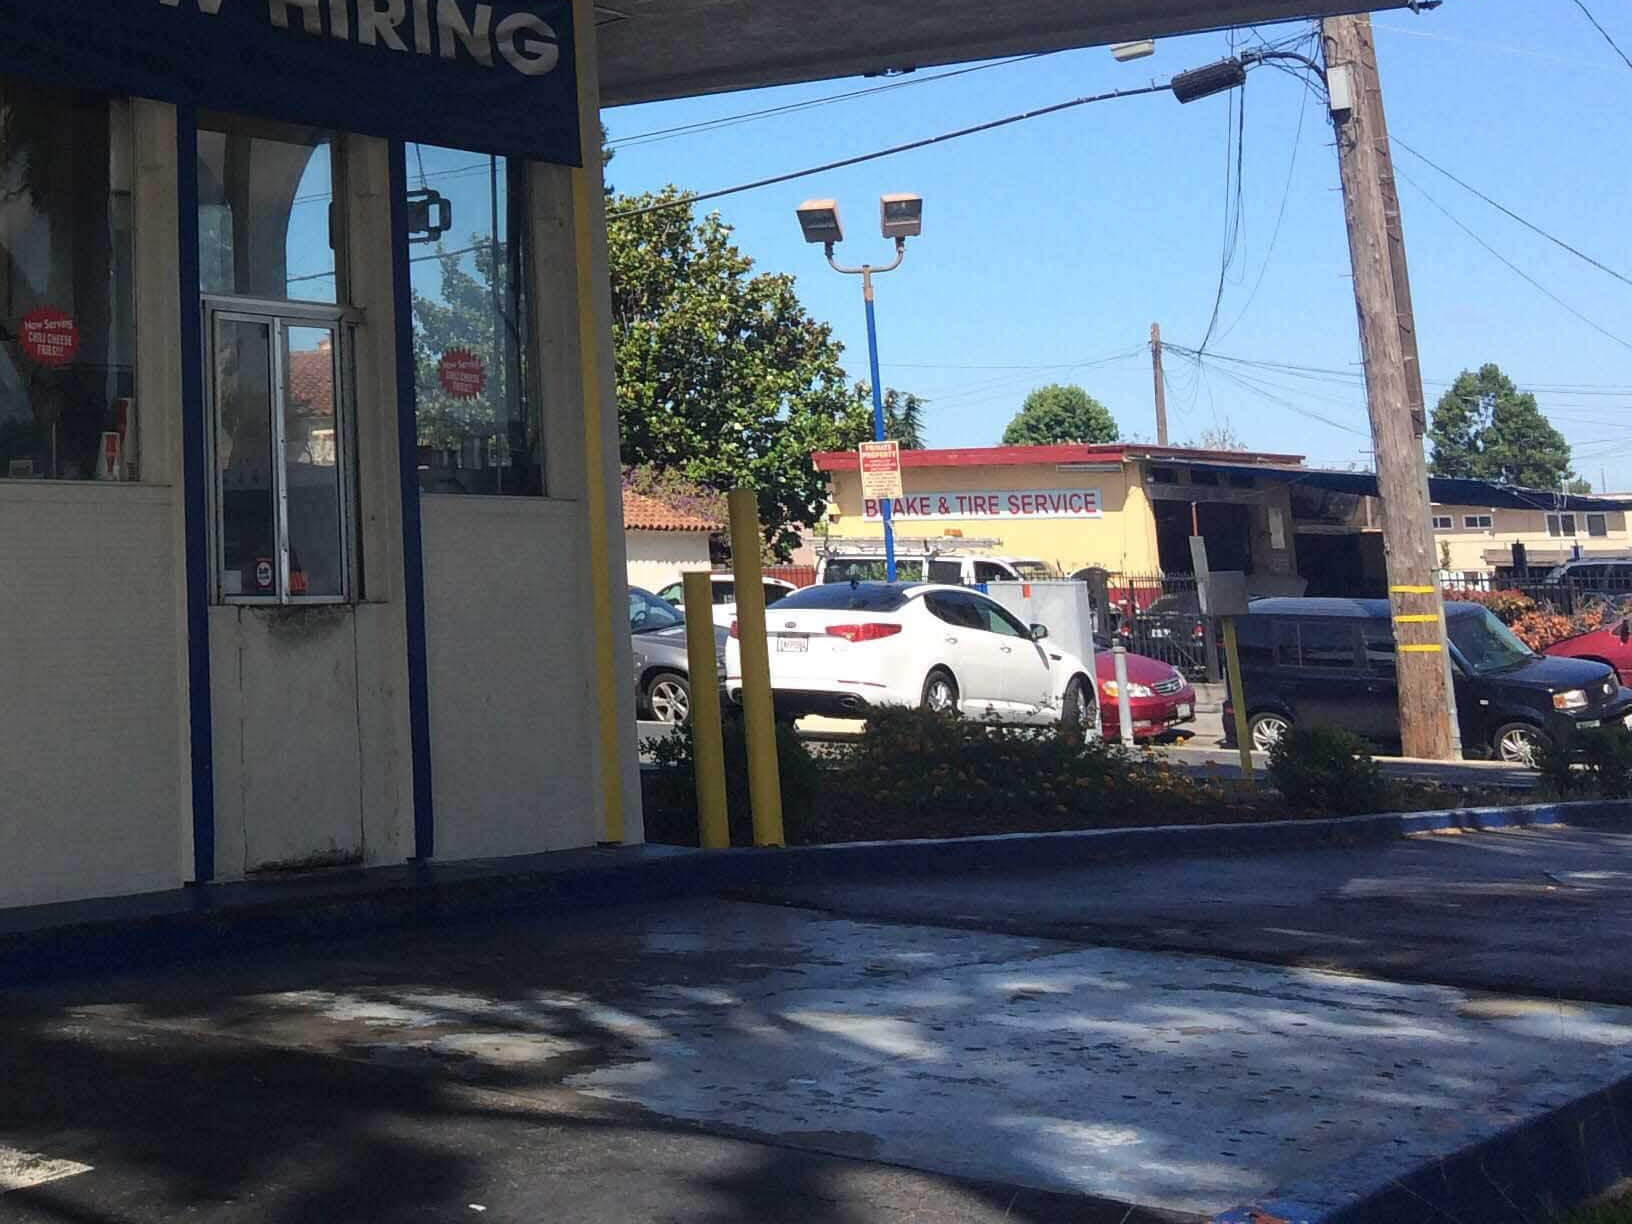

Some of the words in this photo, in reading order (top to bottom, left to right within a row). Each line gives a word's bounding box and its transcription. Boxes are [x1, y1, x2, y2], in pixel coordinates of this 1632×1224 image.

[24, 320, 42, 330] Now
[43, 319, 73, 330] Serving
[47, 333, 73, 346] CHEESE
[937, 496, 951, 515] &
[955, 495, 1000, 516] TIRE
[1007, 492, 1097, 515] SERVICE
